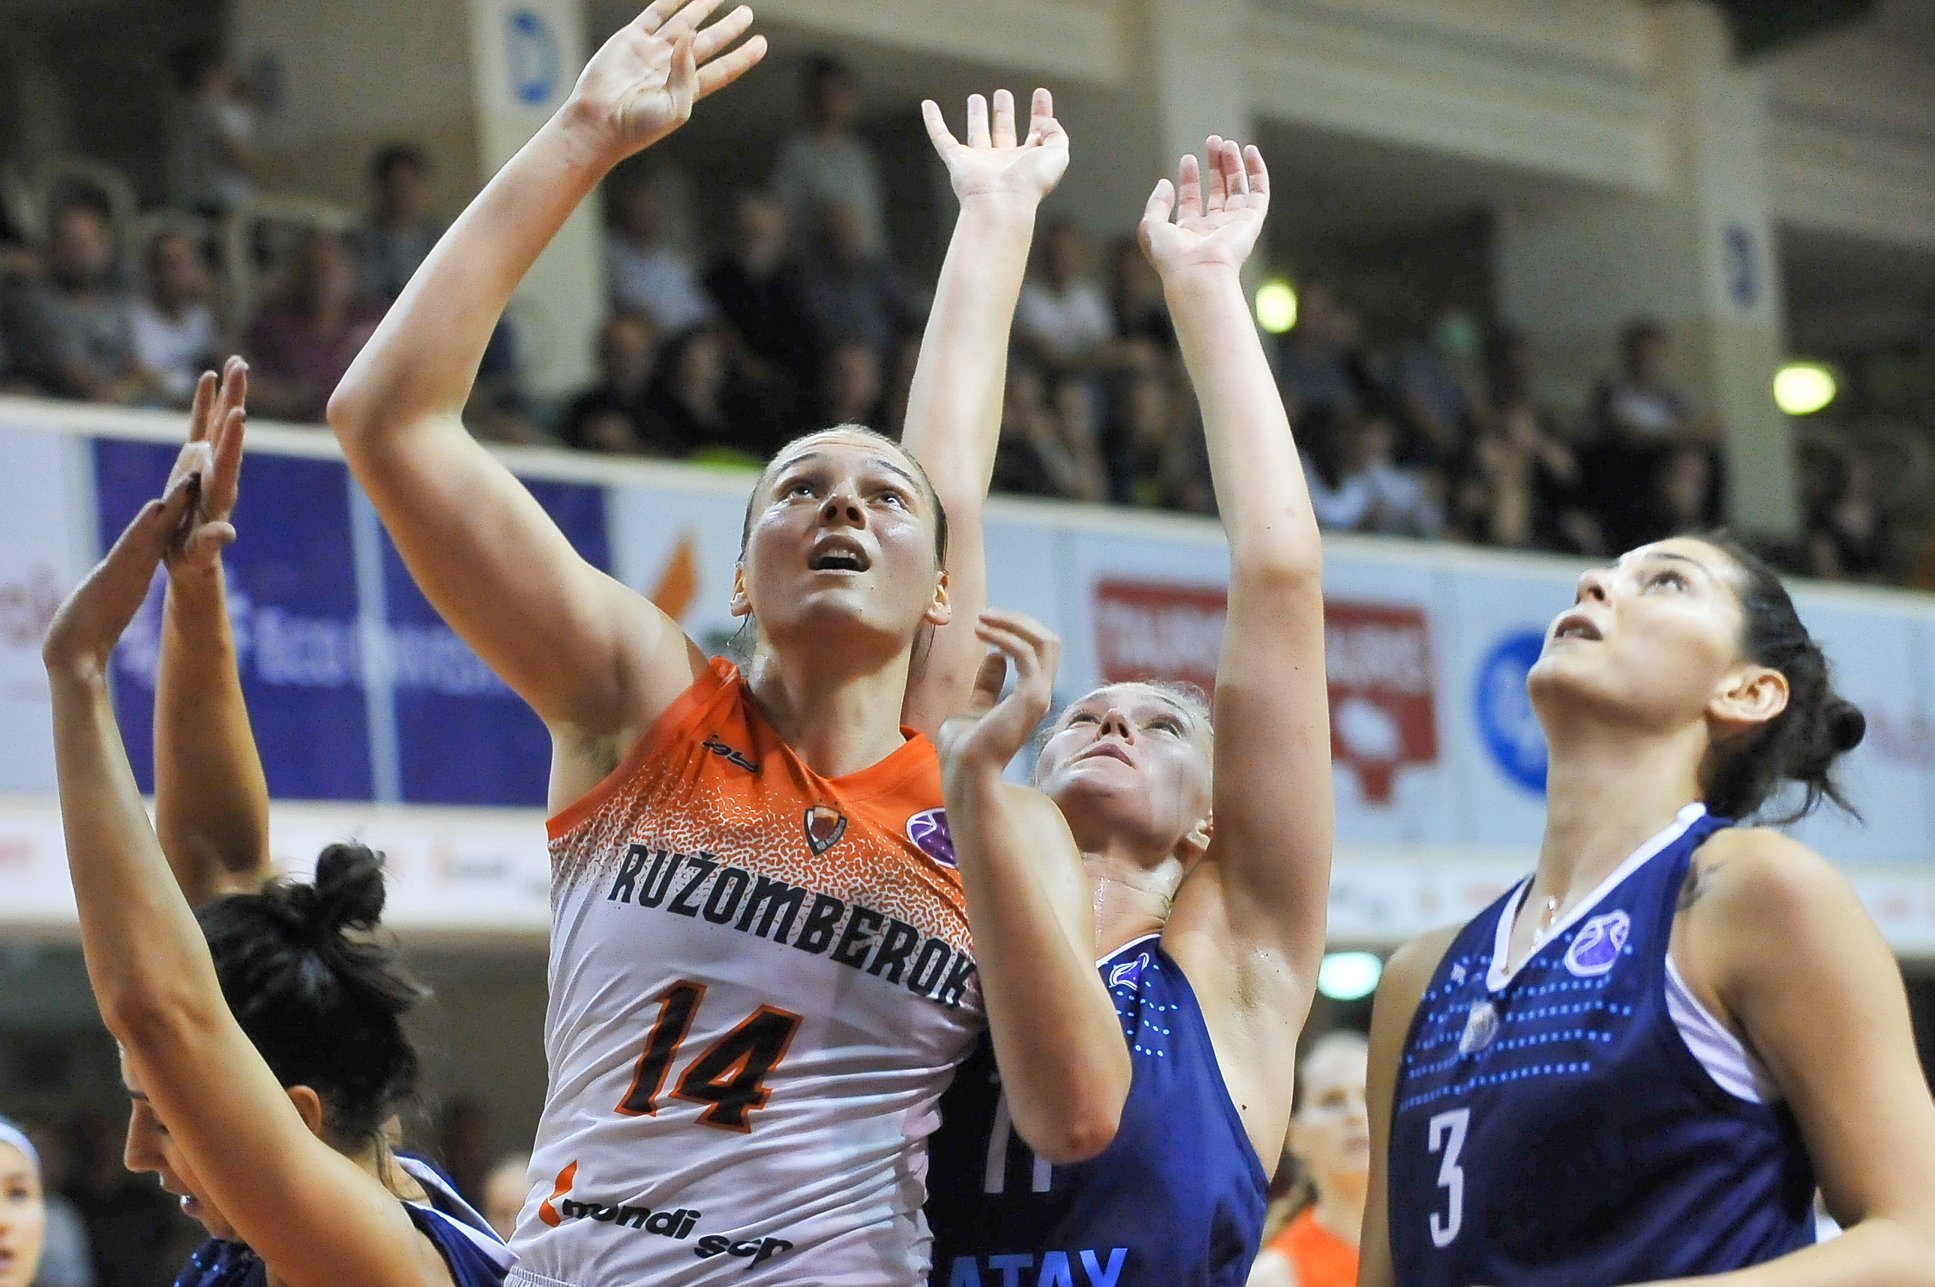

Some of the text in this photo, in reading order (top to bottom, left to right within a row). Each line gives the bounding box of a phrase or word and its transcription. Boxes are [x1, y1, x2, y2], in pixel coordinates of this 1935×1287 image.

[608, 843, 977, 1008] RUŽOMBEROK
[614, 979, 804, 1134] 14
[562, 1198, 794, 1271] mondi scp
[1428, 1107, 1470, 1248] 3
